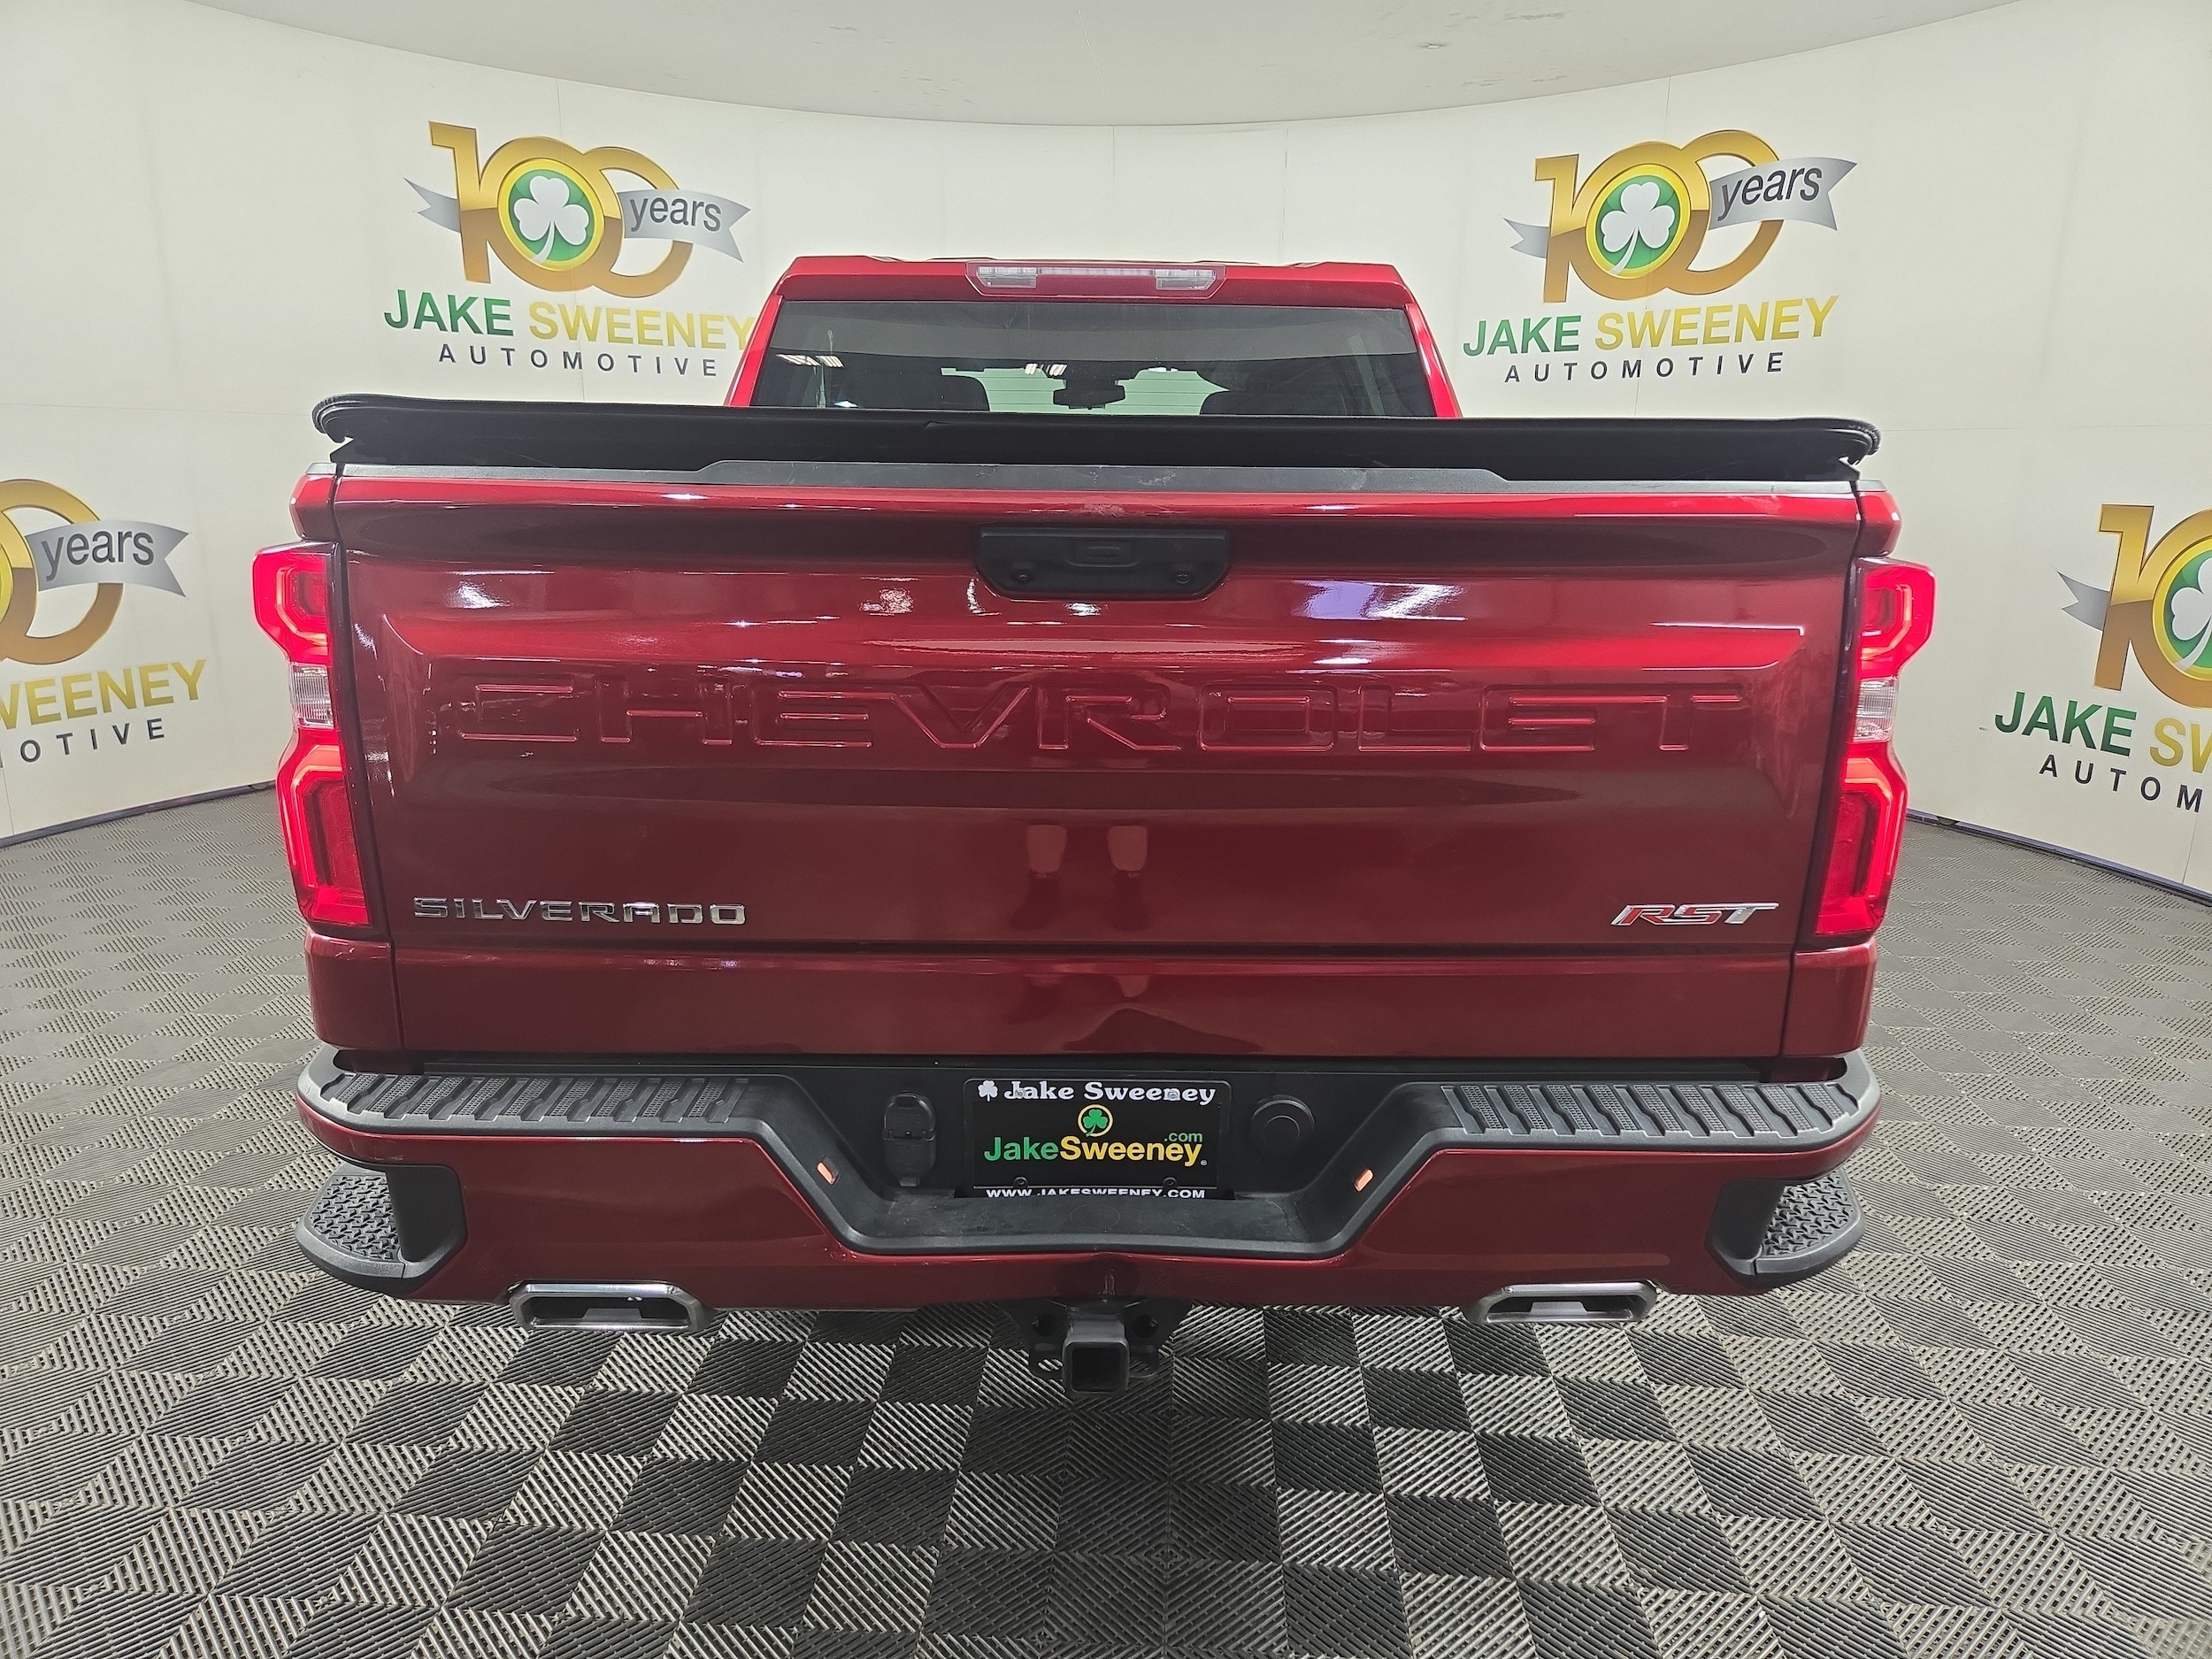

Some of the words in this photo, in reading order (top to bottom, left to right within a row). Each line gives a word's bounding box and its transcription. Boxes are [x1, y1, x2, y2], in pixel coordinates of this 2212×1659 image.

[429, 120, 693, 298] 100
[629, 197, 722, 233] years
[1535, 129, 1783, 303] 100
[1717, 167, 1823, 221] years
[384, 288, 514, 337] JAKE
[529, 301, 757, 350] SWEENEY
[1463, 315, 1582, 357] JAKE
[1594, 295, 1839, 350] SWEENEY
[439, 342, 717, 376] AUTOMOTIVE
[1504, 351, 1784, 383] AUTOMOTIVE
[41, 530, 155, 581] years
[455, 673, 1745, 752] CHEVROLET
[1994, 690, 2138, 757] JAKE
[0, 718, 165, 768] OTIVE
[2039, 754, 2203, 813] AUTOM
[413, 896, 746, 925] SILVERADO
[1610, 902, 1779, 926] RST
[1003, 1080, 1075, 1101] Jake
[1084, 1081, 1217, 1105] Sweeney
